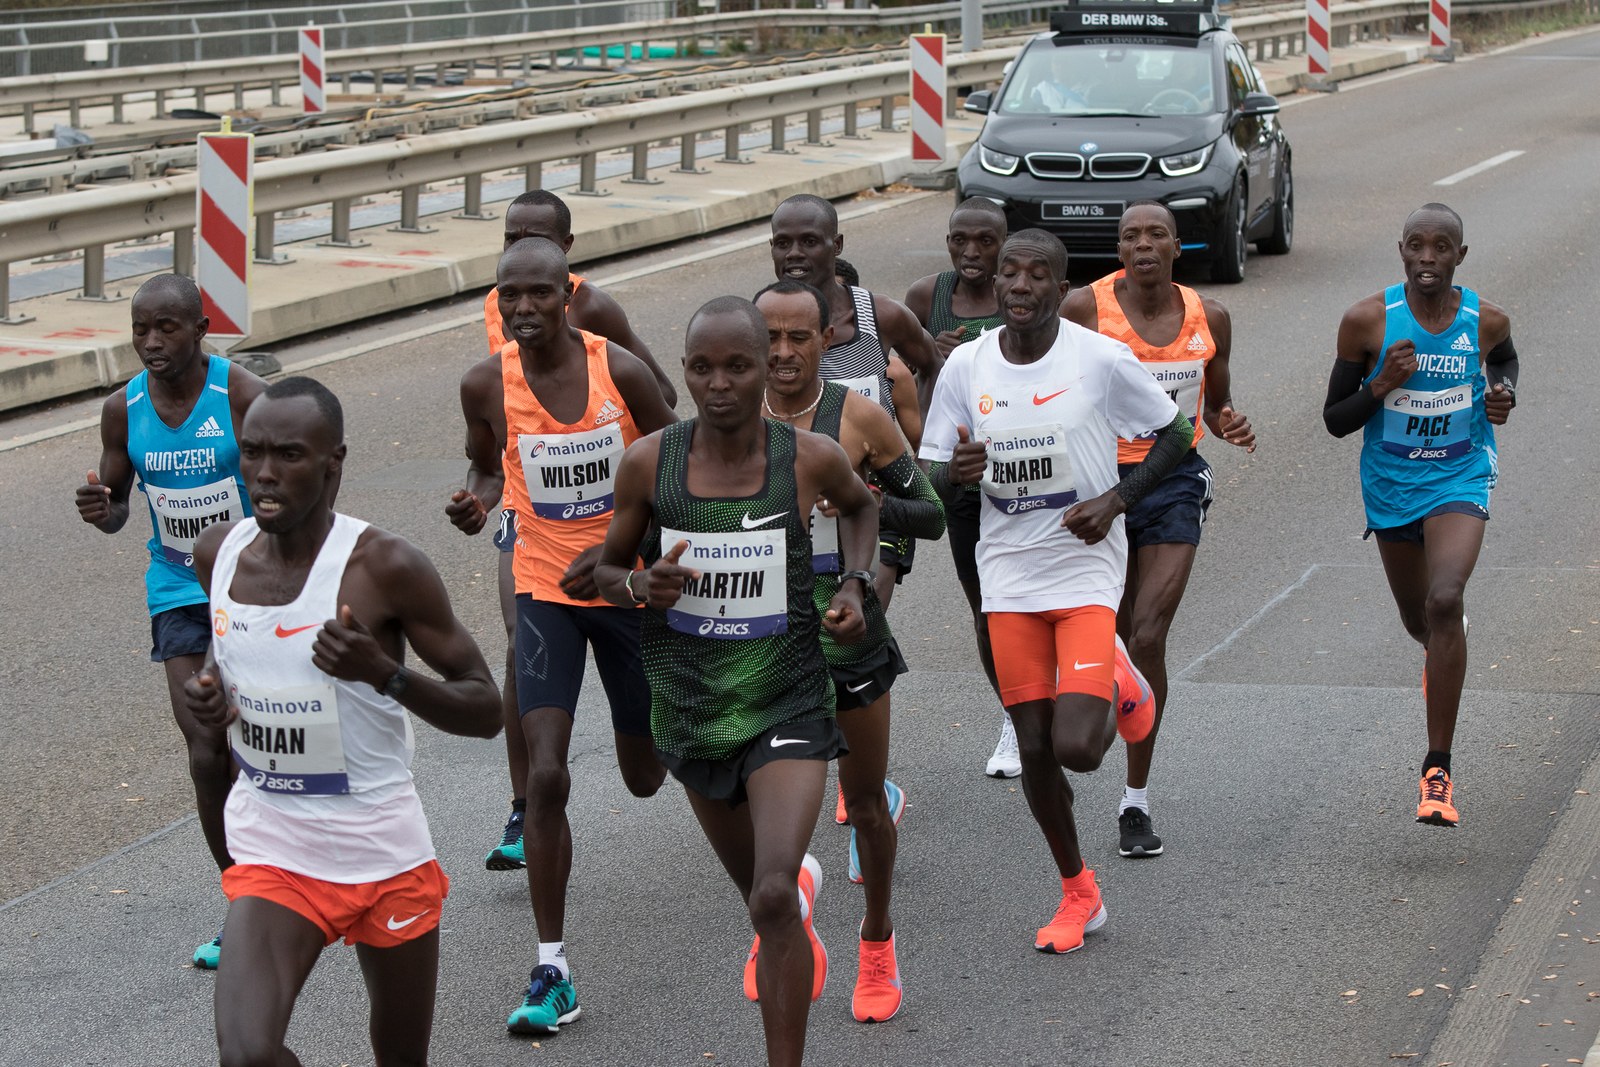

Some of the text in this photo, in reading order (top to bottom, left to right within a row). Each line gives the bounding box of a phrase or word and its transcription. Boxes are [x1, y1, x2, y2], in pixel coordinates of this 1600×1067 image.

[1081, 14, 1108, 25] DER
[1111, 14, 1145, 25] BMW
[1062, 205, 1104, 216] BMW i3s
[1451, 343, 1474, 352] adidas
[1413, 353, 1467, 373] NCZECH
[1152, 370, 1197, 381] ainova
[996, 400, 1009, 408] NN
[1411, 392, 1464, 409] mainova
[595, 409, 624, 425] adidas
[1406, 415, 1451, 437] PACE
[195, 429, 225, 438] adidas
[547, 435, 613, 456] mainova
[993, 435, 1055, 452] mainova
[1423, 438, 1433, 447] 97
[145, 448, 216, 472] RUNCZECH
[1421, 449, 1447, 459] asics
[175, 468, 217, 476] RACING
[541, 457, 610, 488] WILSON
[991, 457, 1053, 484] BENARD
[577, 491, 583, 501] 3
[1017, 486, 1028, 496] 54
[168, 490, 229, 509] mainova
[1019, 499, 1047, 511] asics
[575, 500, 605, 515] asics
[693, 543, 774, 559] mainova
[682, 570, 765, 599] MARTIN
[718, 604, 726, 617] 4
[232, 620, 248, 632] NN
[714, 623, 749, 635] asics
[240, 694, 322, 714] mainova
[241, 718, 305, 755] BRIAN
[269, 759, 276, 771] 9
[266, 778, 304, 791] asics
